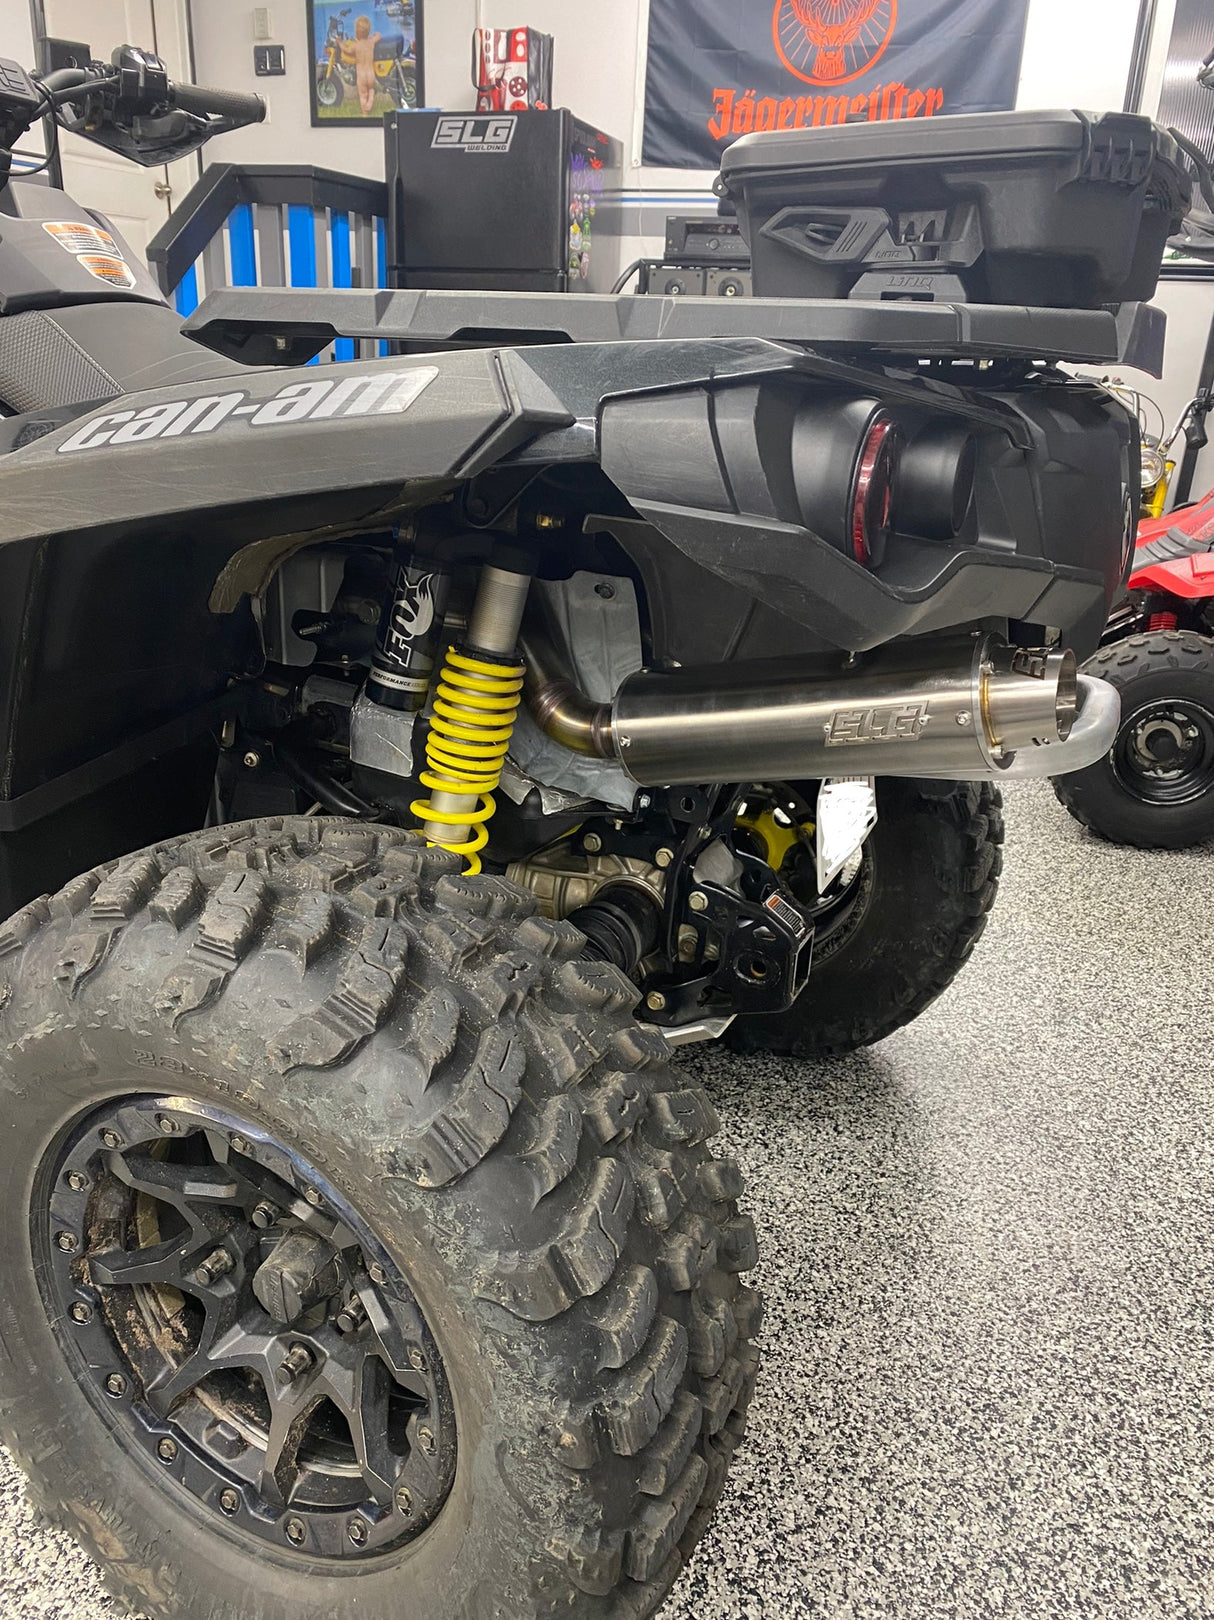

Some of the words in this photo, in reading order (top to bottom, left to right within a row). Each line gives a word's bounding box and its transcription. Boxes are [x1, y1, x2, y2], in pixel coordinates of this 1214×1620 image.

[436, 120, 513, 143] SLG
[383, 566, 434, 668] FOX
[372, 670, 412, 687] PERFORMANCE
[828, 703, 923, 742] SLG
